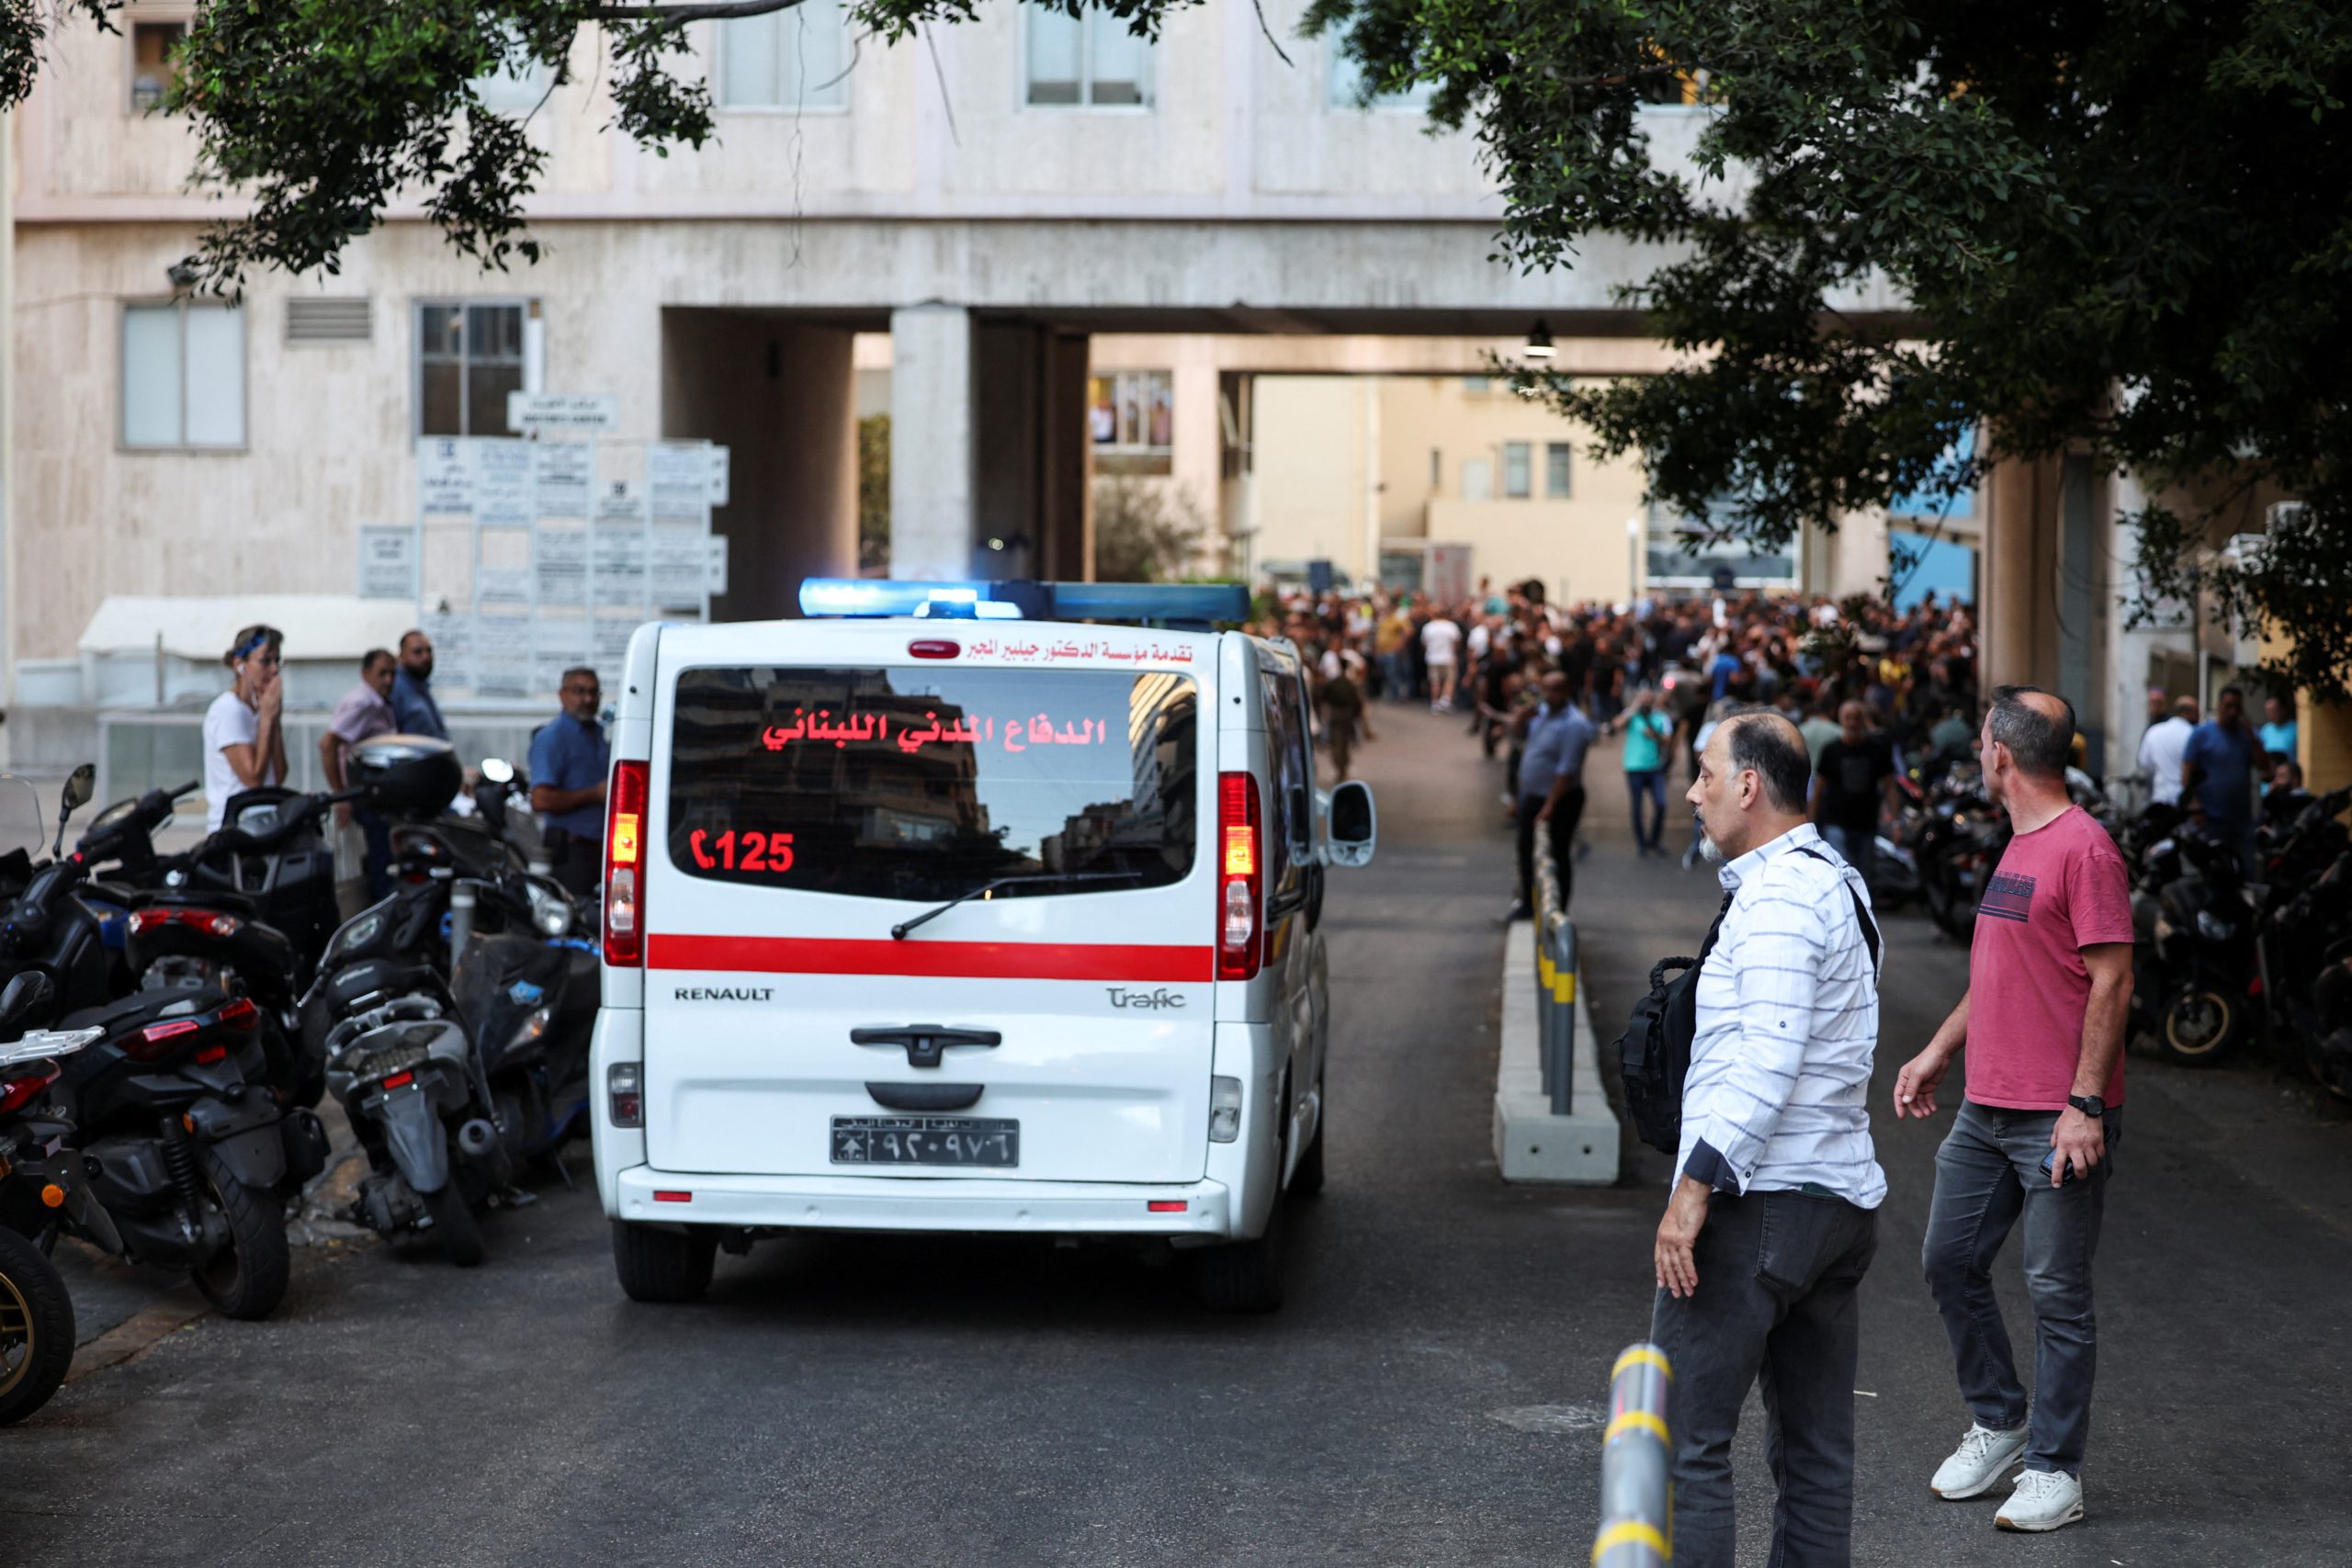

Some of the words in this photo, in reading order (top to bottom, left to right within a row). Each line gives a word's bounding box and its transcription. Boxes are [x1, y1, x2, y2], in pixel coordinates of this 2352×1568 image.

[1043, 639, 1098, 661] الدكتور
[1102, 641, 1148, 665] مؤسسة
[1151, 643, 1193, 662] تقدمة
[762, 707, 888, 750] اللبناني
[897, 711, 993, 753] المدني
[1003, 712, 1105, 751] الدفاع
[715, 829, 795, 872] 125
[674, 987, 775, 1001] RENAULT
[1105, 987, 1186, 1010] Trafic
[882, 1133, 1009, 1161] ٩٢٠٩٧٦
